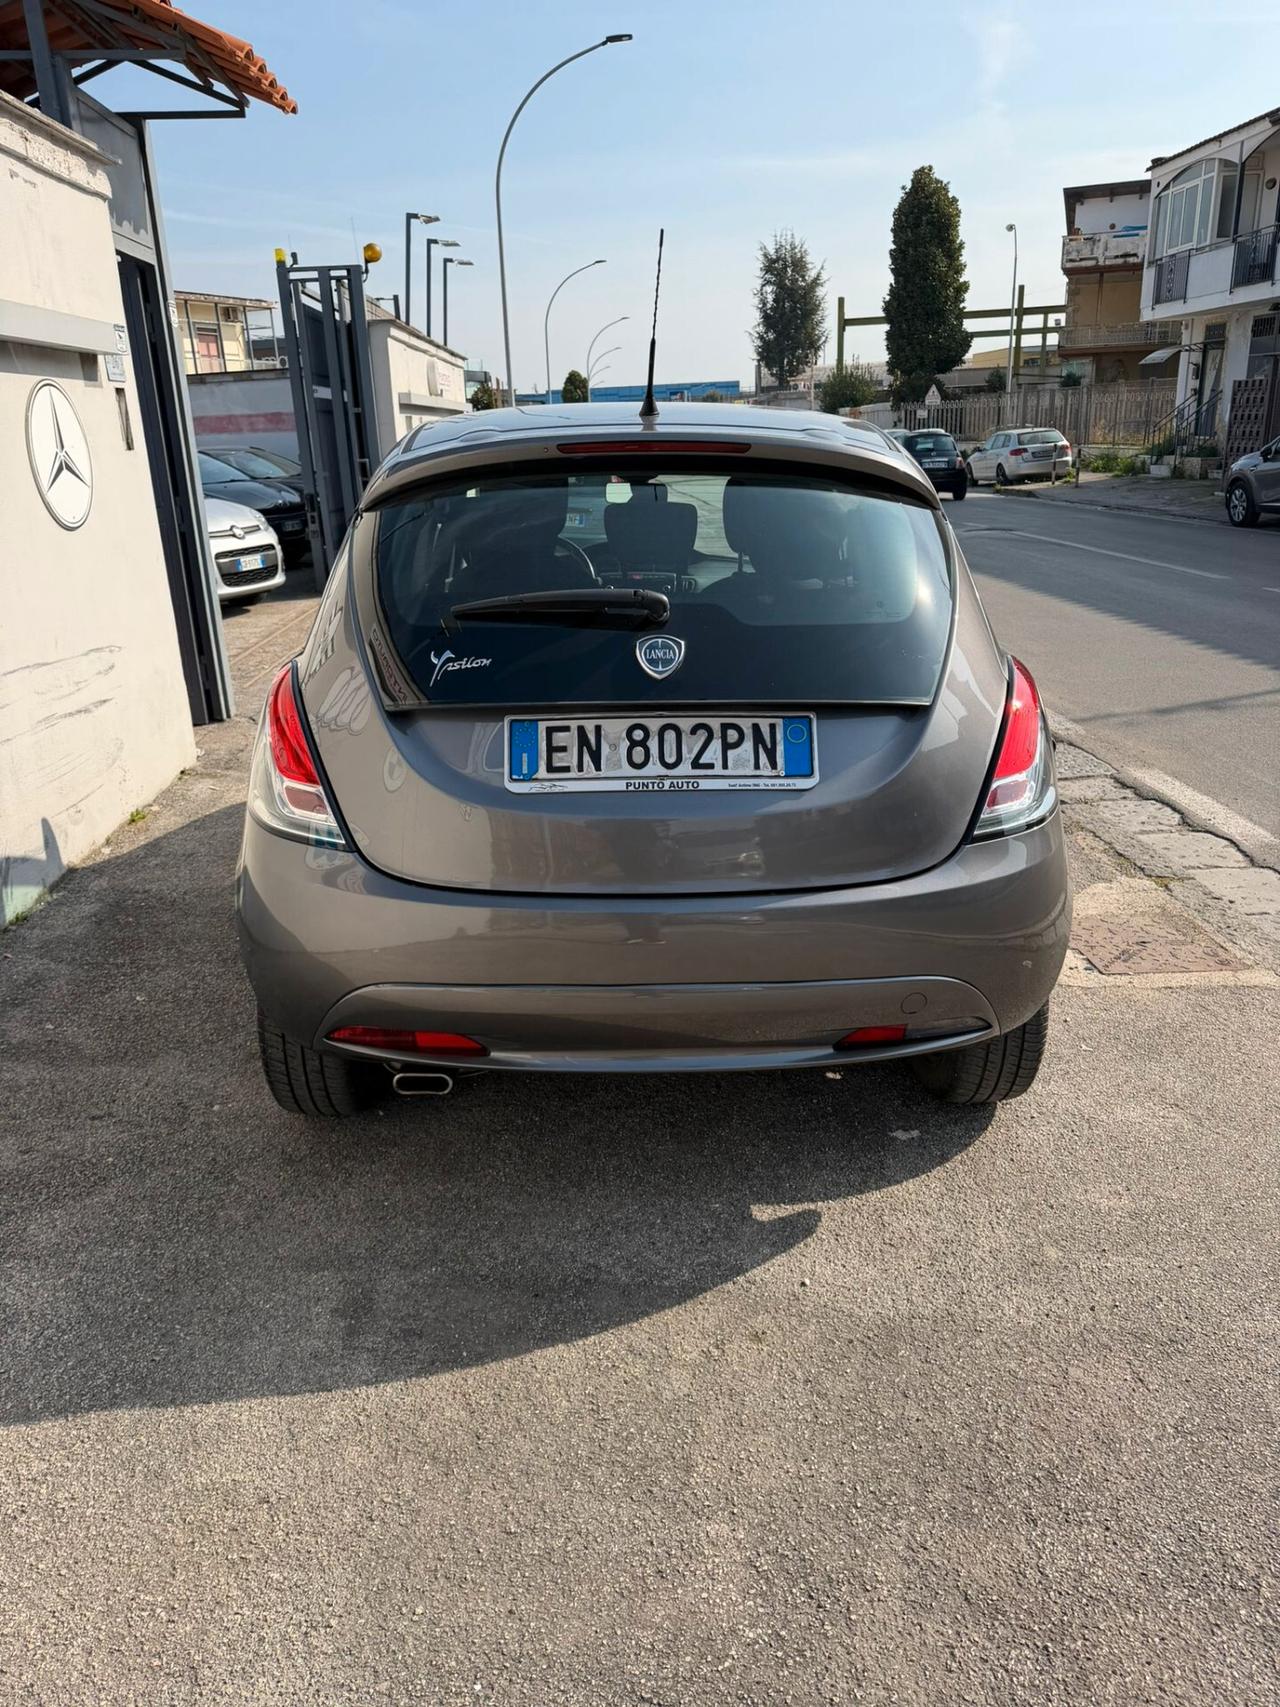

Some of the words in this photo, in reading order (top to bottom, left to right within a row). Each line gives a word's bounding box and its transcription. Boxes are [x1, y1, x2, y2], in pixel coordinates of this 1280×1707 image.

[645, 649, 675, 659] LANCIA
[429, 649, 492, 687] Ypsilon
[546, 724, 602, 773] EN
[626, 723, 778, 770] 802PN
[625, 781, 665, 791] PUNTO
[668, 780, 700, 790] AUTO
